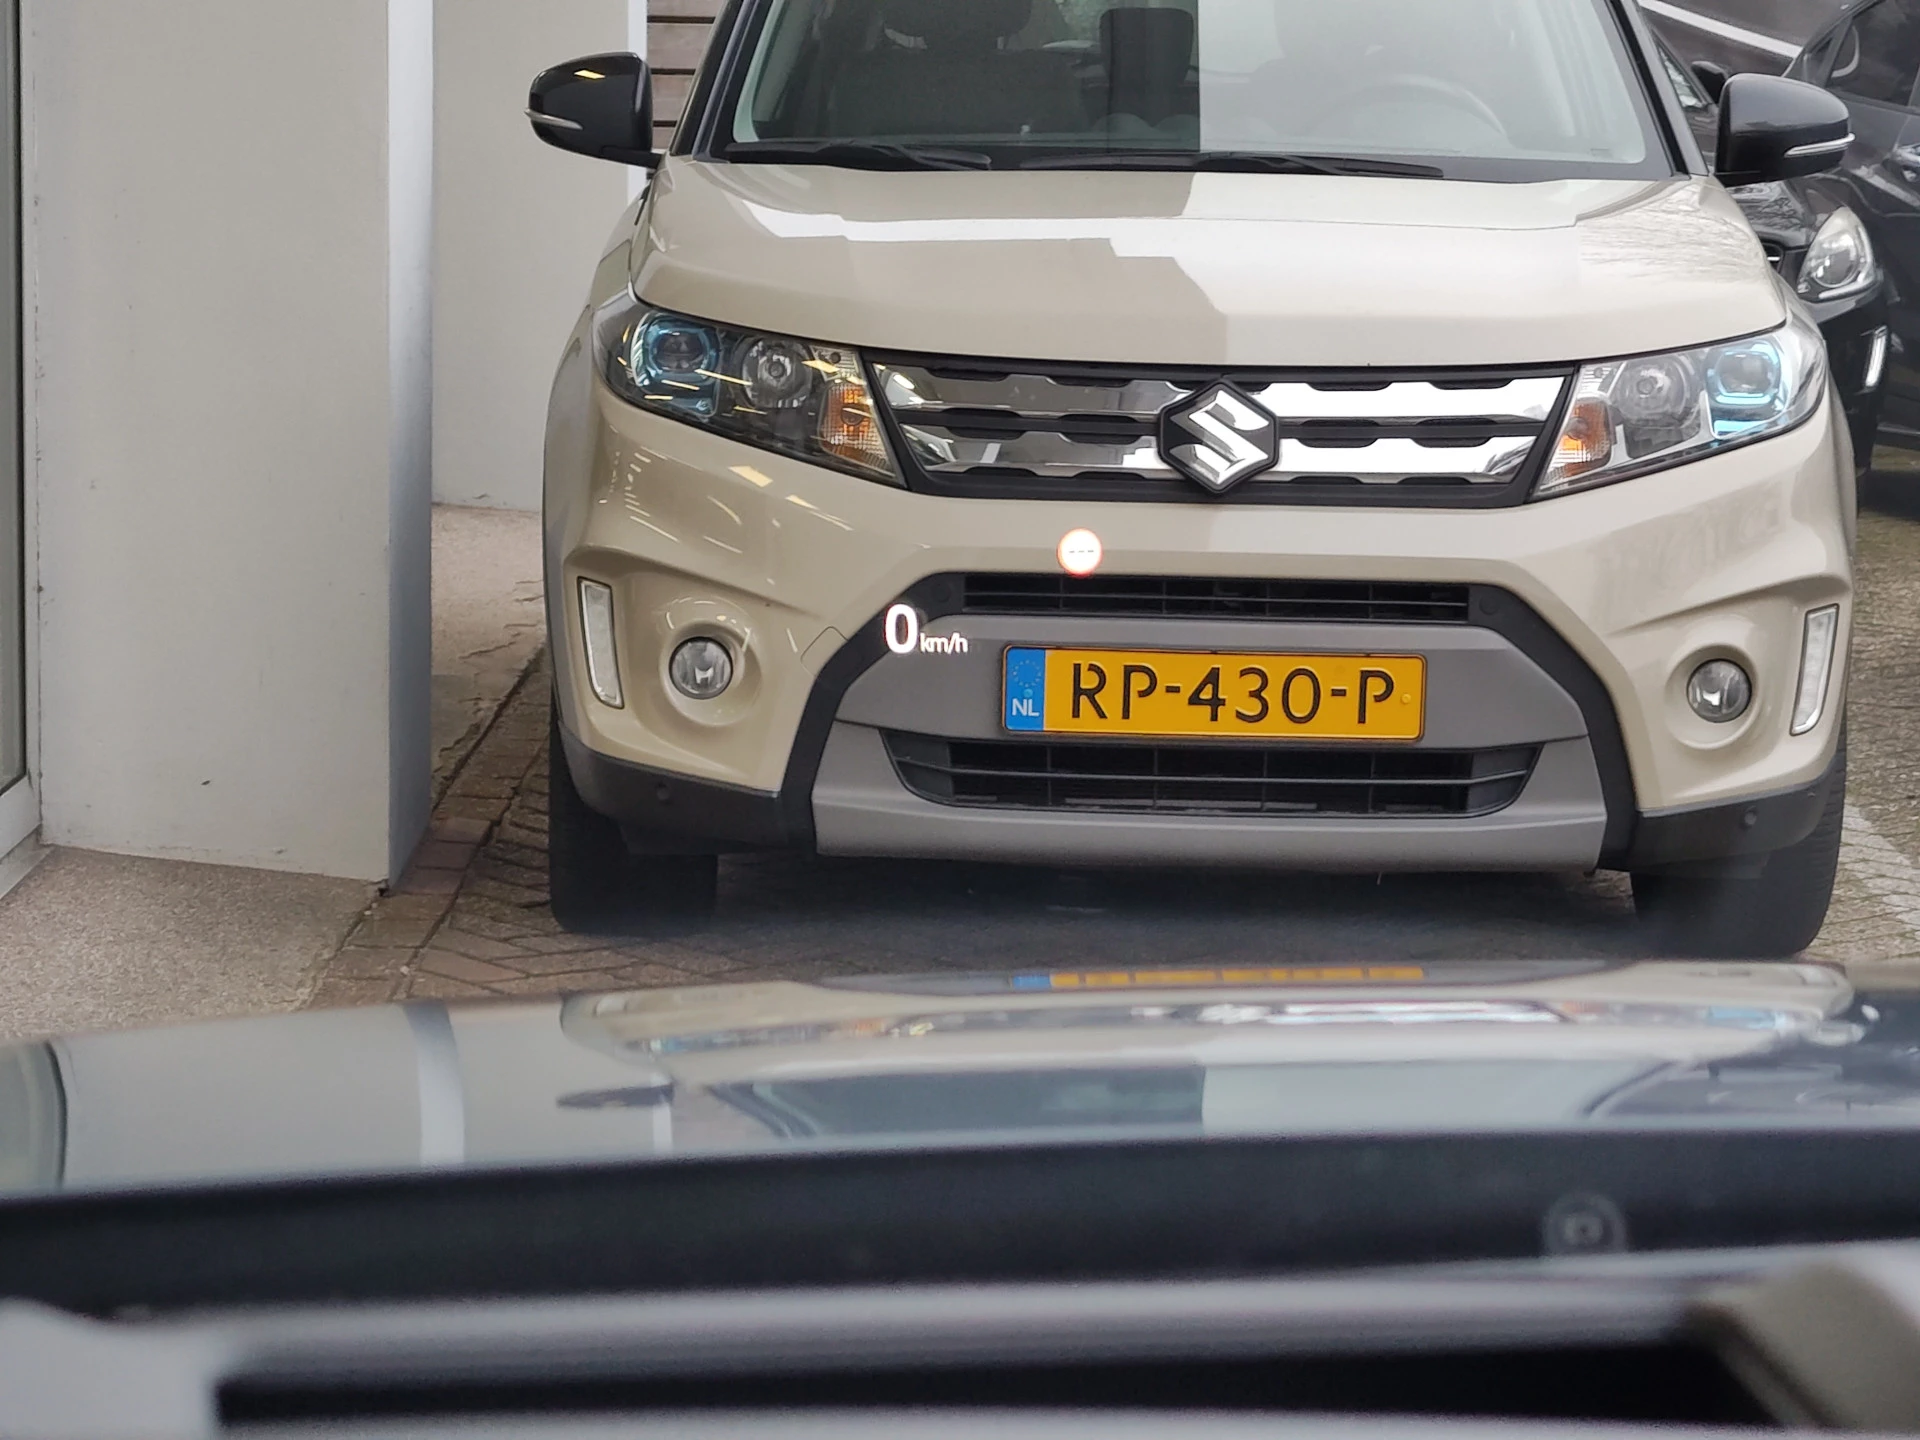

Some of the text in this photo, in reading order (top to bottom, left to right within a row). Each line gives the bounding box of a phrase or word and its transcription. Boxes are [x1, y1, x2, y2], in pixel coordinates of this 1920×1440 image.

[884, 603, 969, 655] 0 km/h
[1011, 697, 1040, 717] NL
[1071, 662, 1395, 725] RP-430-P
